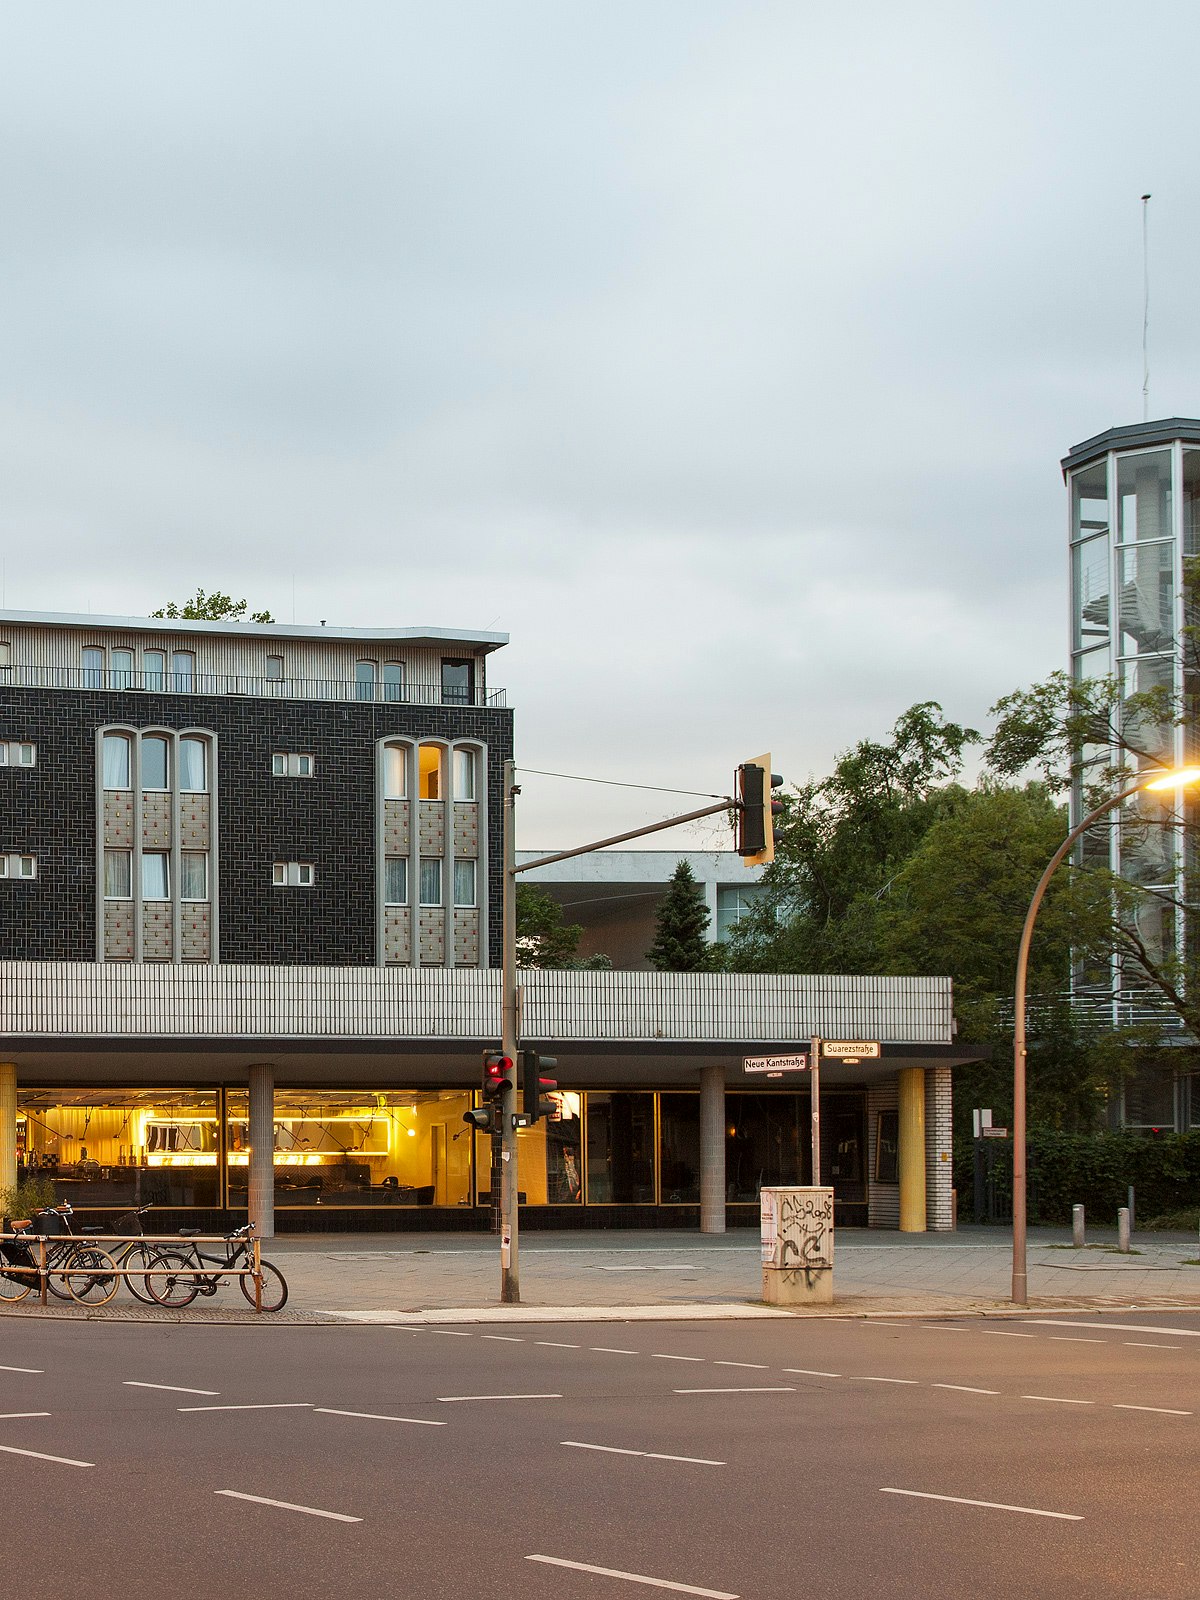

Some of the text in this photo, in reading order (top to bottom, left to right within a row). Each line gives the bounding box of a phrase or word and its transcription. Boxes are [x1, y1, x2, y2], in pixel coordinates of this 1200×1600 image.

[827, 1043, 874, 1054] Suarezstraße
[745, 1057, 804, 1068] Neue Kantstraße
